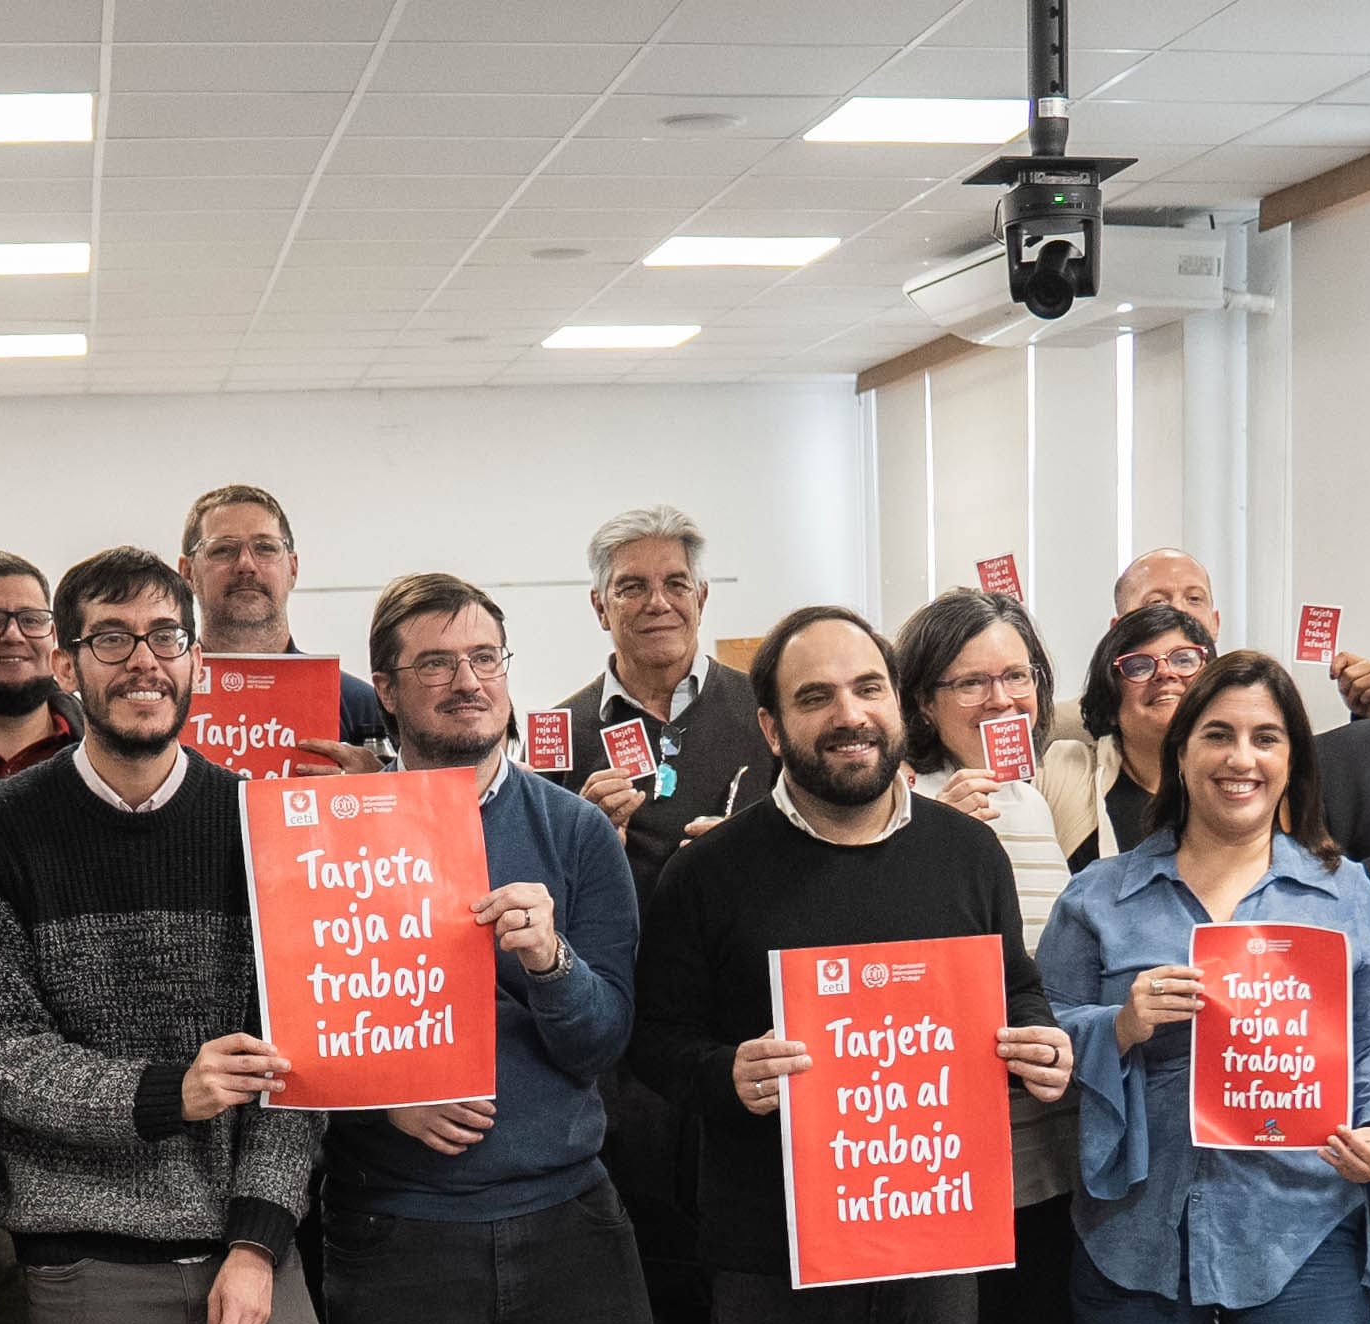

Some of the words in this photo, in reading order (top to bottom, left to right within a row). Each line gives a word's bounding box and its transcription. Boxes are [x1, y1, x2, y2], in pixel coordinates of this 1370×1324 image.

[189, 712, 296, 757] Tarjeta
[535, 715, 560, 725] Tarjeta
[535, 735, 562, 745] trabajo
[536, 726, 550, 736] roja
[552, 724, 560, 733] al
[535, 746, 564, 755] infantil
[295, 845, 435, 900] Tarjeta
[312, 901, 390, 957] roja
[399, 896, 433, 939] al
[306, 953, 445, 1007] trabajo
[1221, 971, 1312, 1008] Tarjeta
[316, 1004, 454, 1058] infantil
[825, 1014, 955, 1068] Tarjeta
[1229, 1007, 1280, 1044] roja
[1284, 1008, 1309, 1037] al
[1221, 1045, 1316, 1081] trabajo
[836, 1070, 909, 1124] roja
[916, 1065, 950, 1108] al
[1223, 1079, 1322, 1110] infantil
[828, 1120, 962, 1174] trabajo
[836, 1170, 974, 1223] infantil
